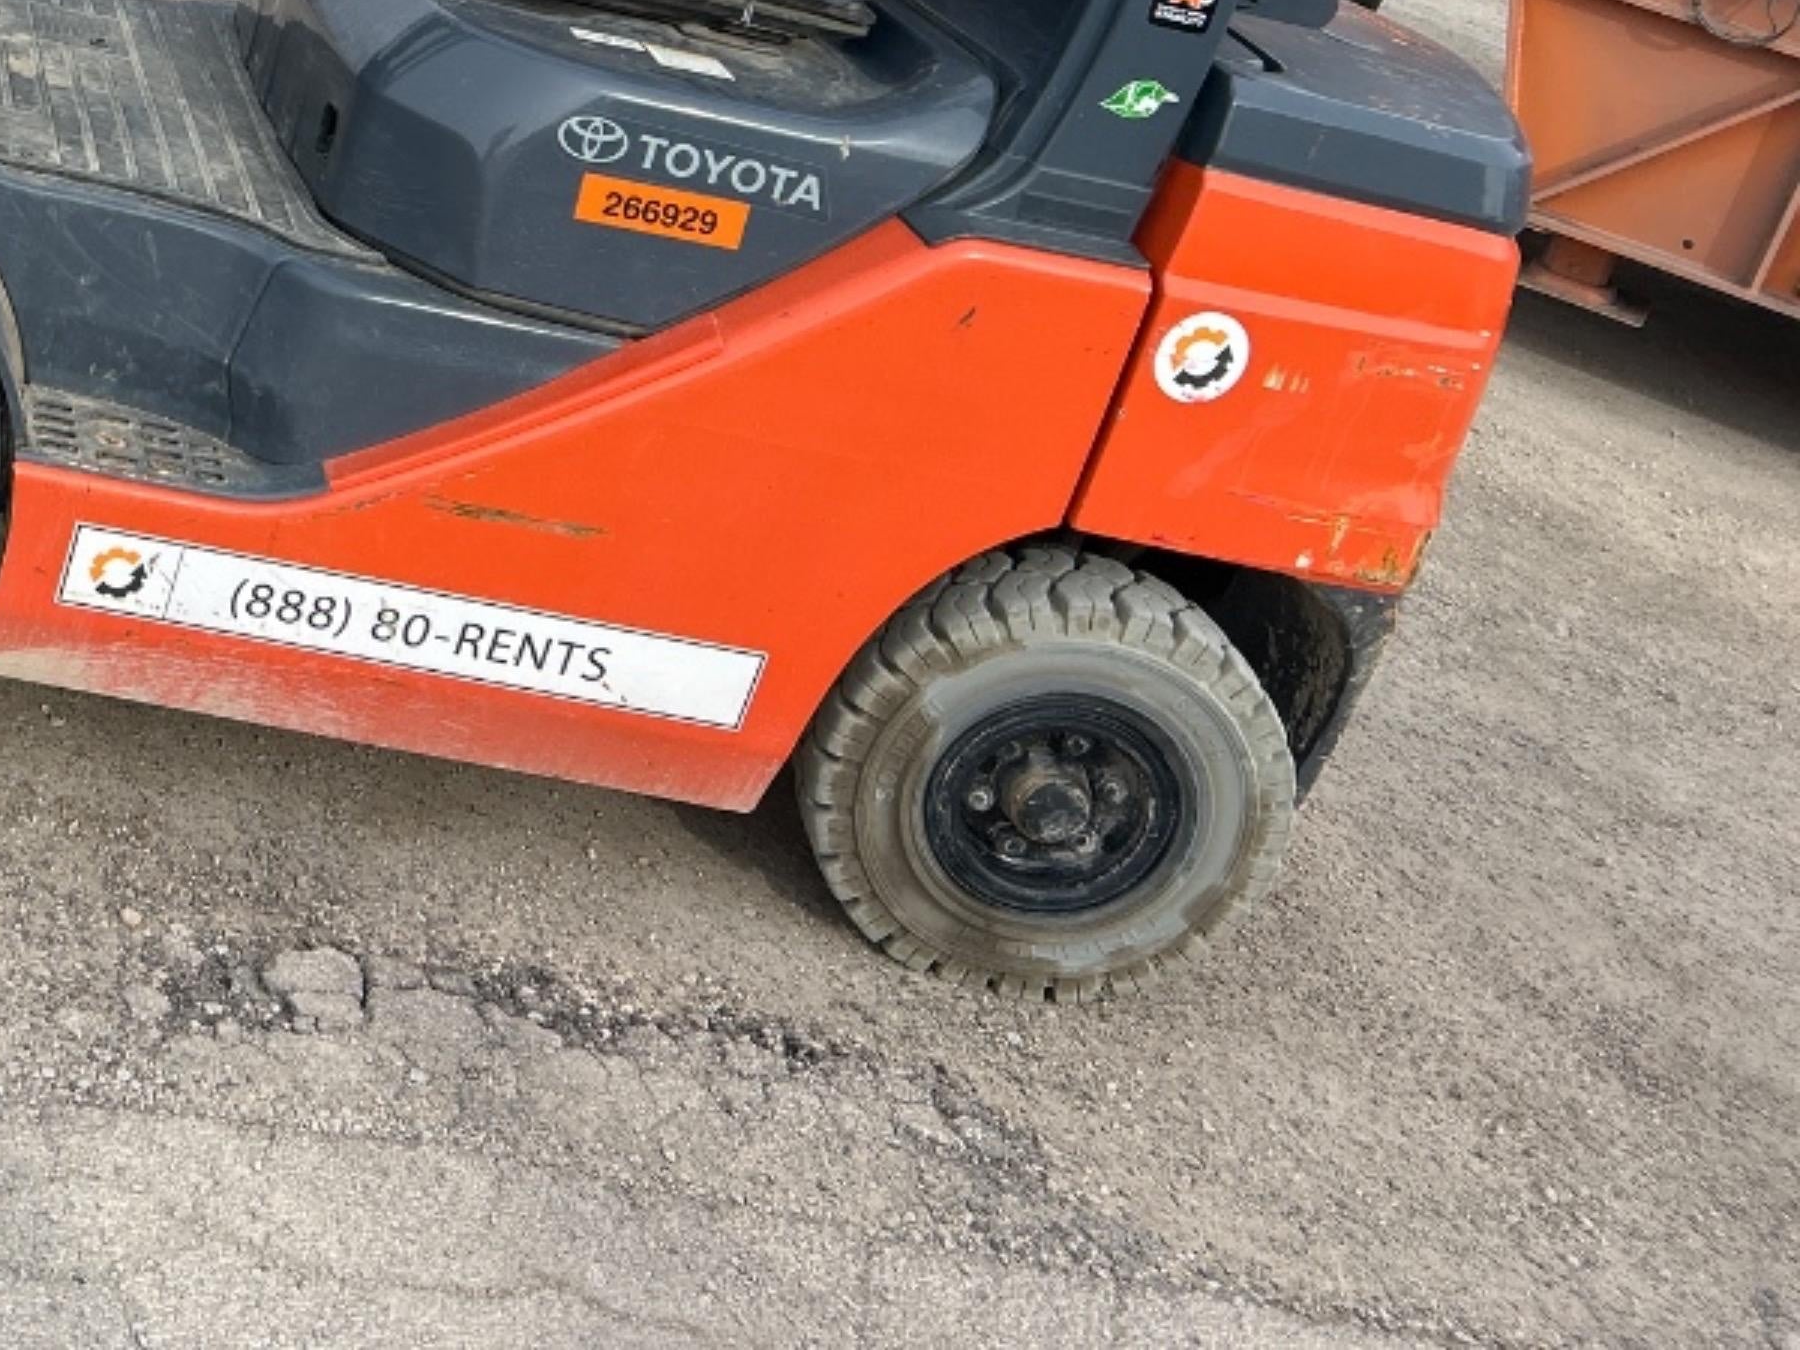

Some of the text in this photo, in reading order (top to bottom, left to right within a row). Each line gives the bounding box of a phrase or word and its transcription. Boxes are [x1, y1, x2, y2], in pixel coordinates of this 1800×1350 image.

[639, 134, 821, 211] TOYOTA
[601, 191, 718, 235] 266929
[231, 578, 613, 683] (888) 80-RENTS
